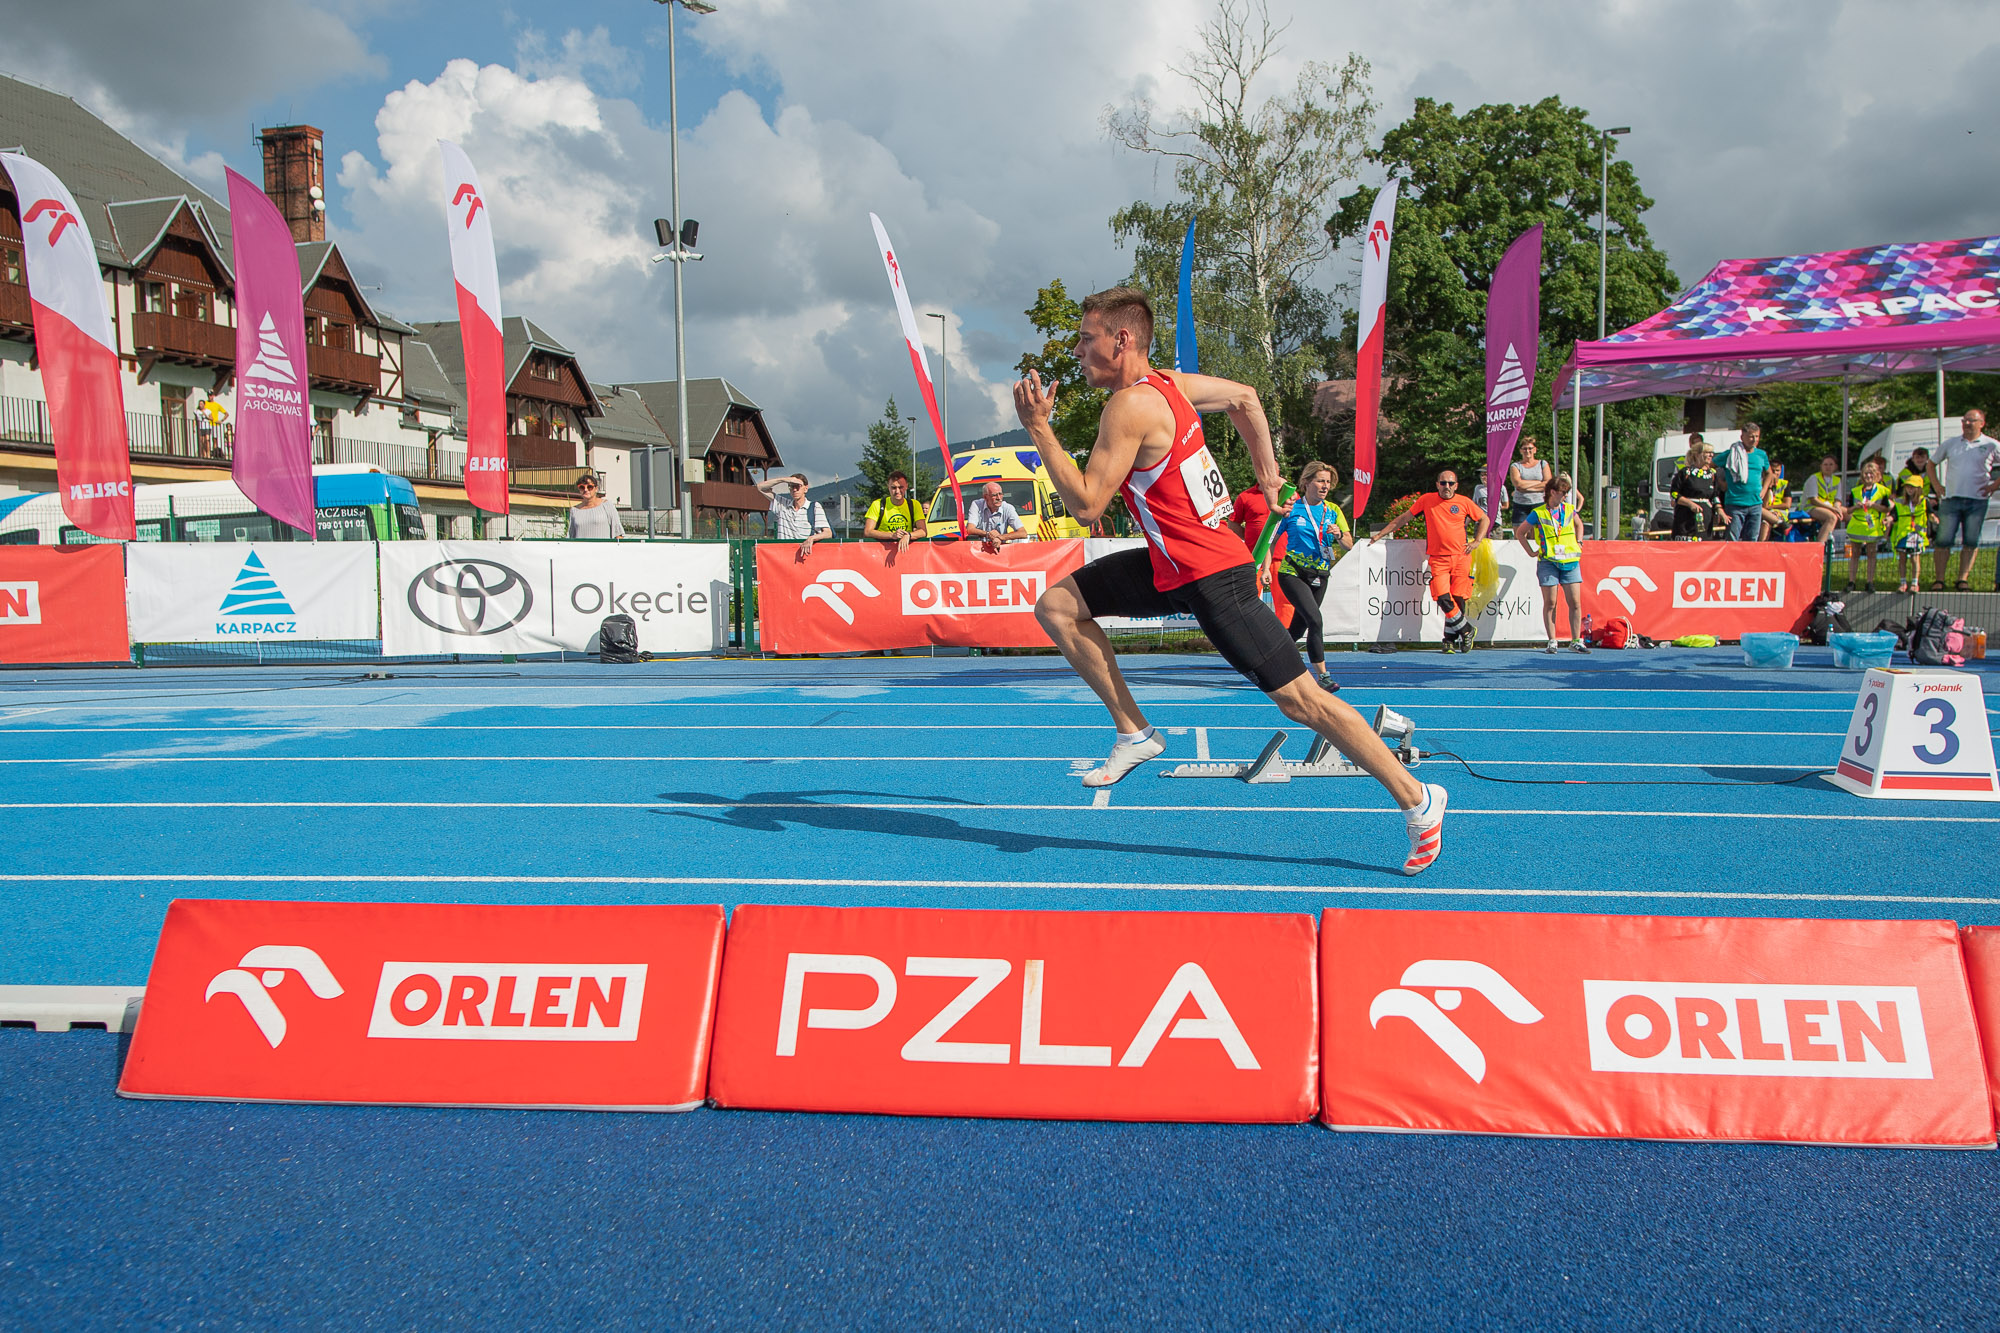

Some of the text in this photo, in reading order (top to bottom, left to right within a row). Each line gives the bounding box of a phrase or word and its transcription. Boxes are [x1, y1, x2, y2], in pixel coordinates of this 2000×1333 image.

[1746, 287, 2000, 322] KARPAC
[910, 578, 1037, 609] ORLEN
[1368, 567, 1432, 586] Ministe
[1680, 577, 1777, 602] ORLEN
[571, 581, 708, 622] Okęcie
[1367, 597, 1431, 619] Sportu
[216, 622, 296, 634] KARPACZ
[1855, 692, 1878, 757] 3
[1912, 698, 1960, 765] 3
[390, 973, 628, 1028] ORLEN
[775, 952, 1262, 1070] PZLA
[1605, 994, 1907, 1063] ORLEN
